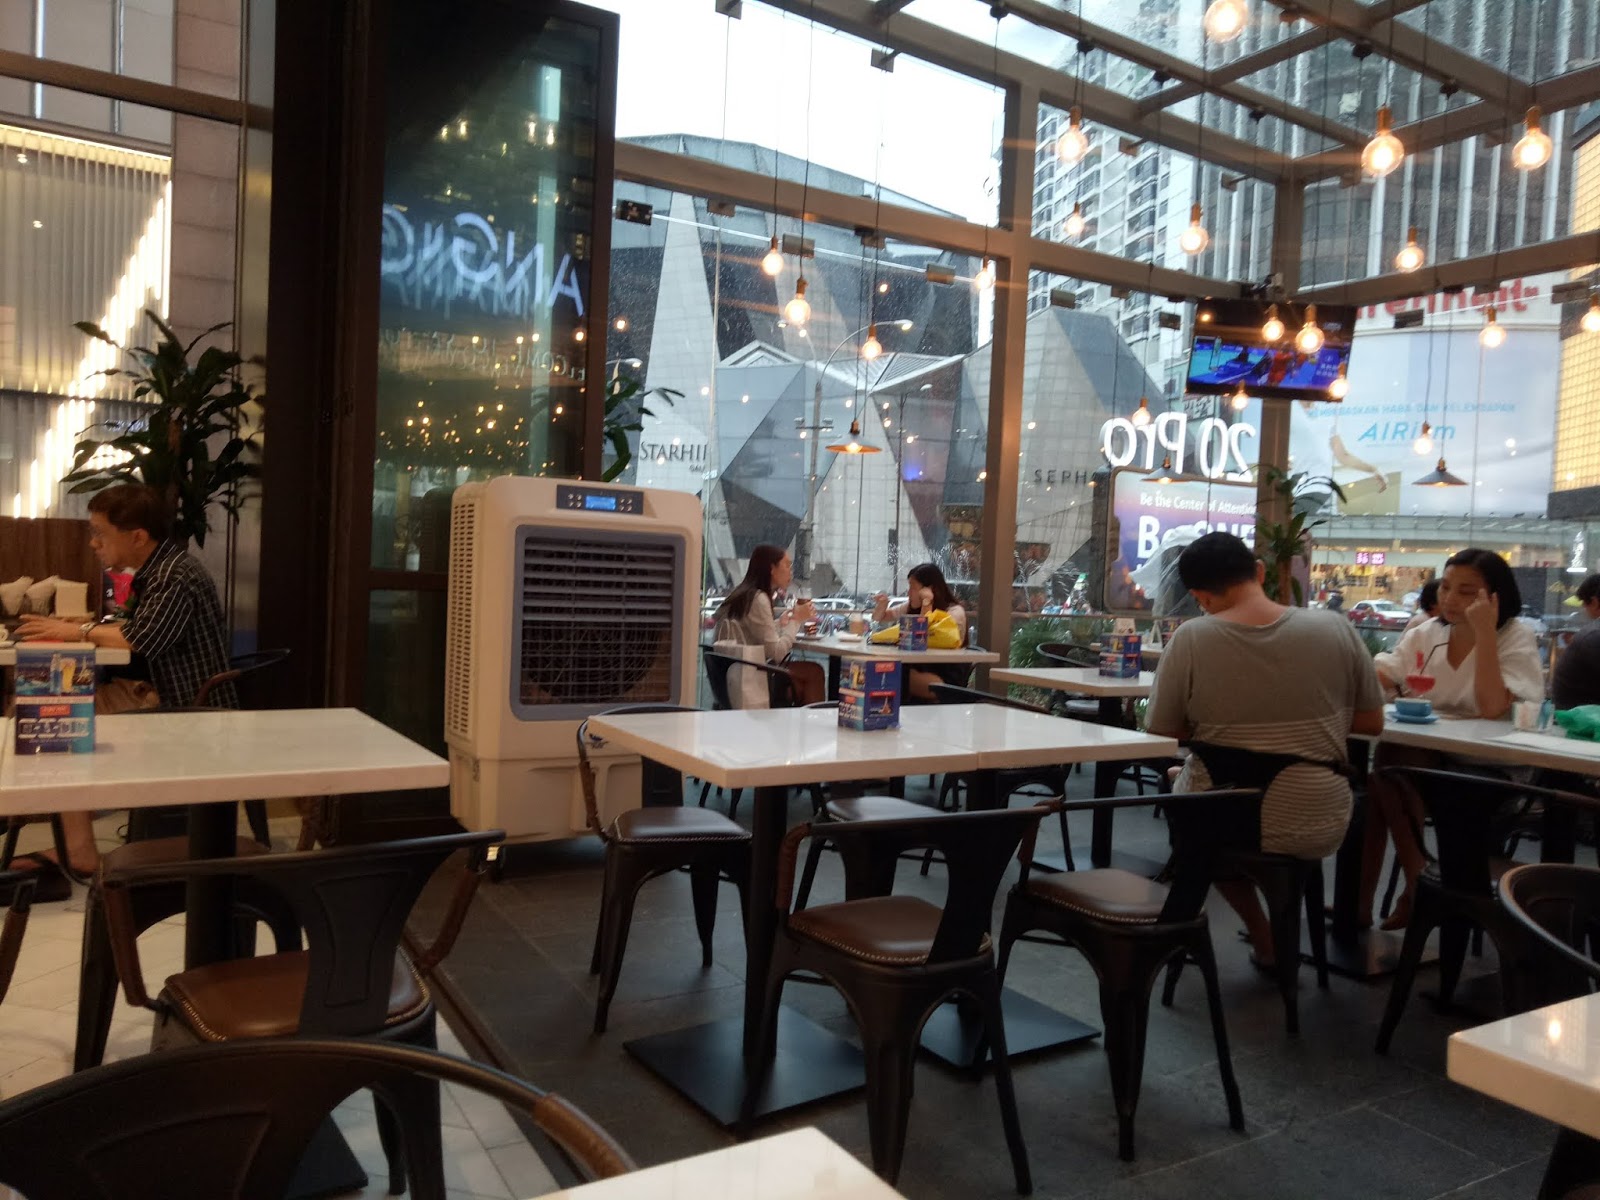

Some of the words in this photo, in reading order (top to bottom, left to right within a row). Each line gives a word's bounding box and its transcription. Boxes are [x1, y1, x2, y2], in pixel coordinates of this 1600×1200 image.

[1357, 421, 1457, 441] AIRim
[1140, 492, 1152, 506] Be
[1155, 491, 1171, 508] the
[1173, 497, 1205, 512] Center
